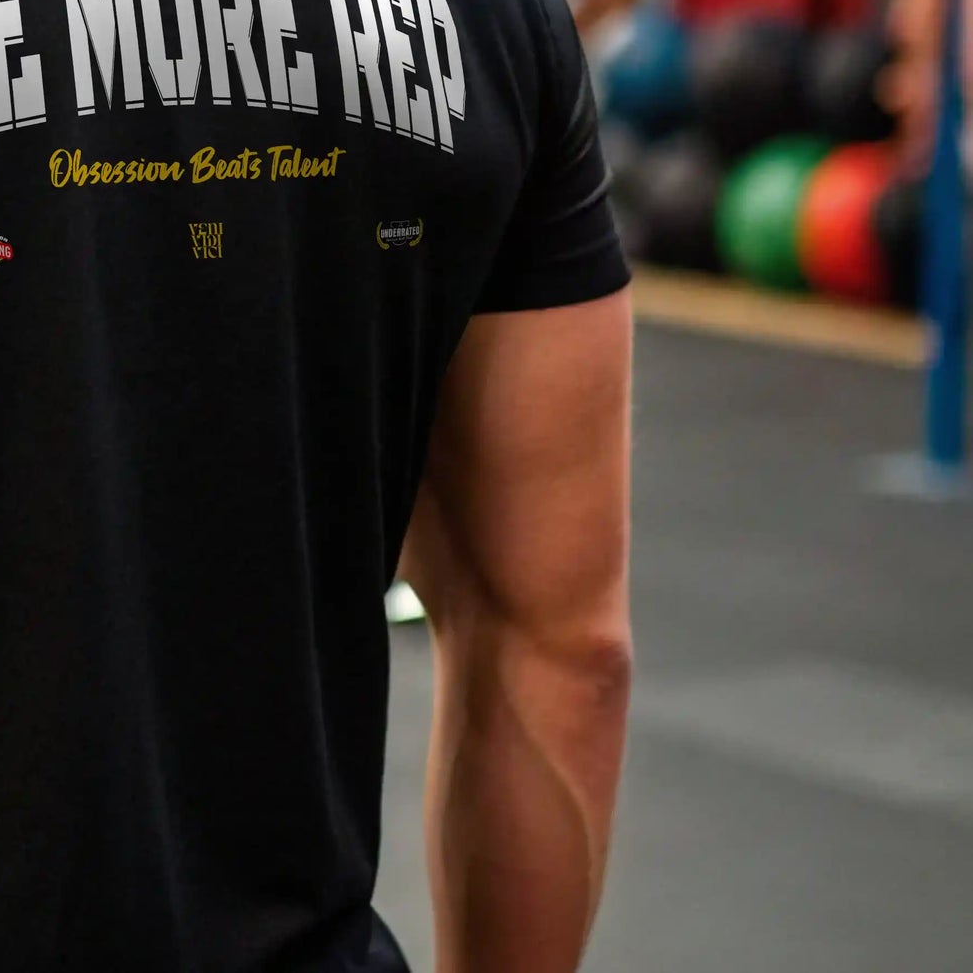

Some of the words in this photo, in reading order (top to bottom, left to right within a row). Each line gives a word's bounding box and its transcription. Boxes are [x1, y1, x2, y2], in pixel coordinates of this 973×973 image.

[49, 148, 184, 188] Obsession
[189, 146, 261, 184] Beats
[267, 145, 346, 181] Talent
[380, 226, 420, 238] UNDERRATED
[192, 246, 223, 259] VICI
